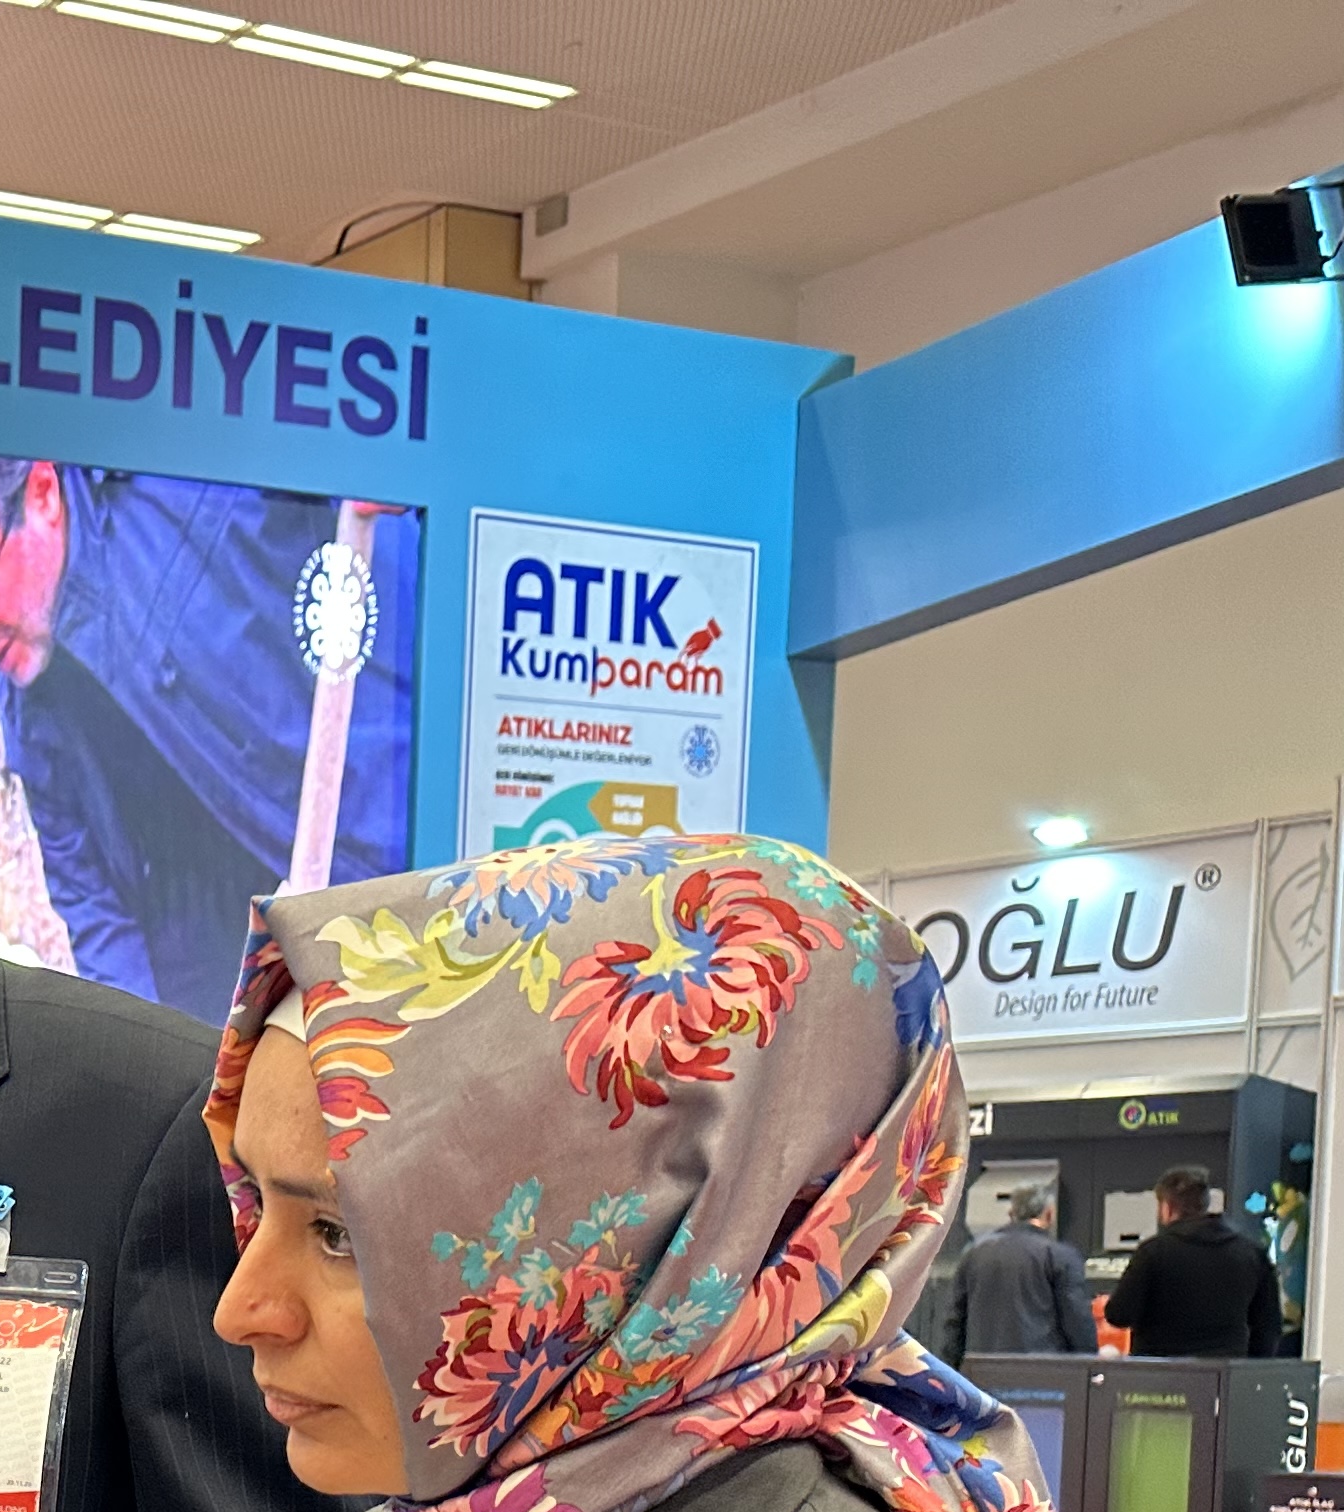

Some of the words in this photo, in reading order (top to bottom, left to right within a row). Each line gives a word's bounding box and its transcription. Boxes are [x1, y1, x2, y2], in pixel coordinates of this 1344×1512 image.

[503, 557, 680, 650] ATIK
[497, 713, 633, 746] ATIKLARINIZ
[994, 989, 1058, 1021] Design
[1063, 986, 1090, 1017] for
[1094, 982, 1160, 1009] Future
